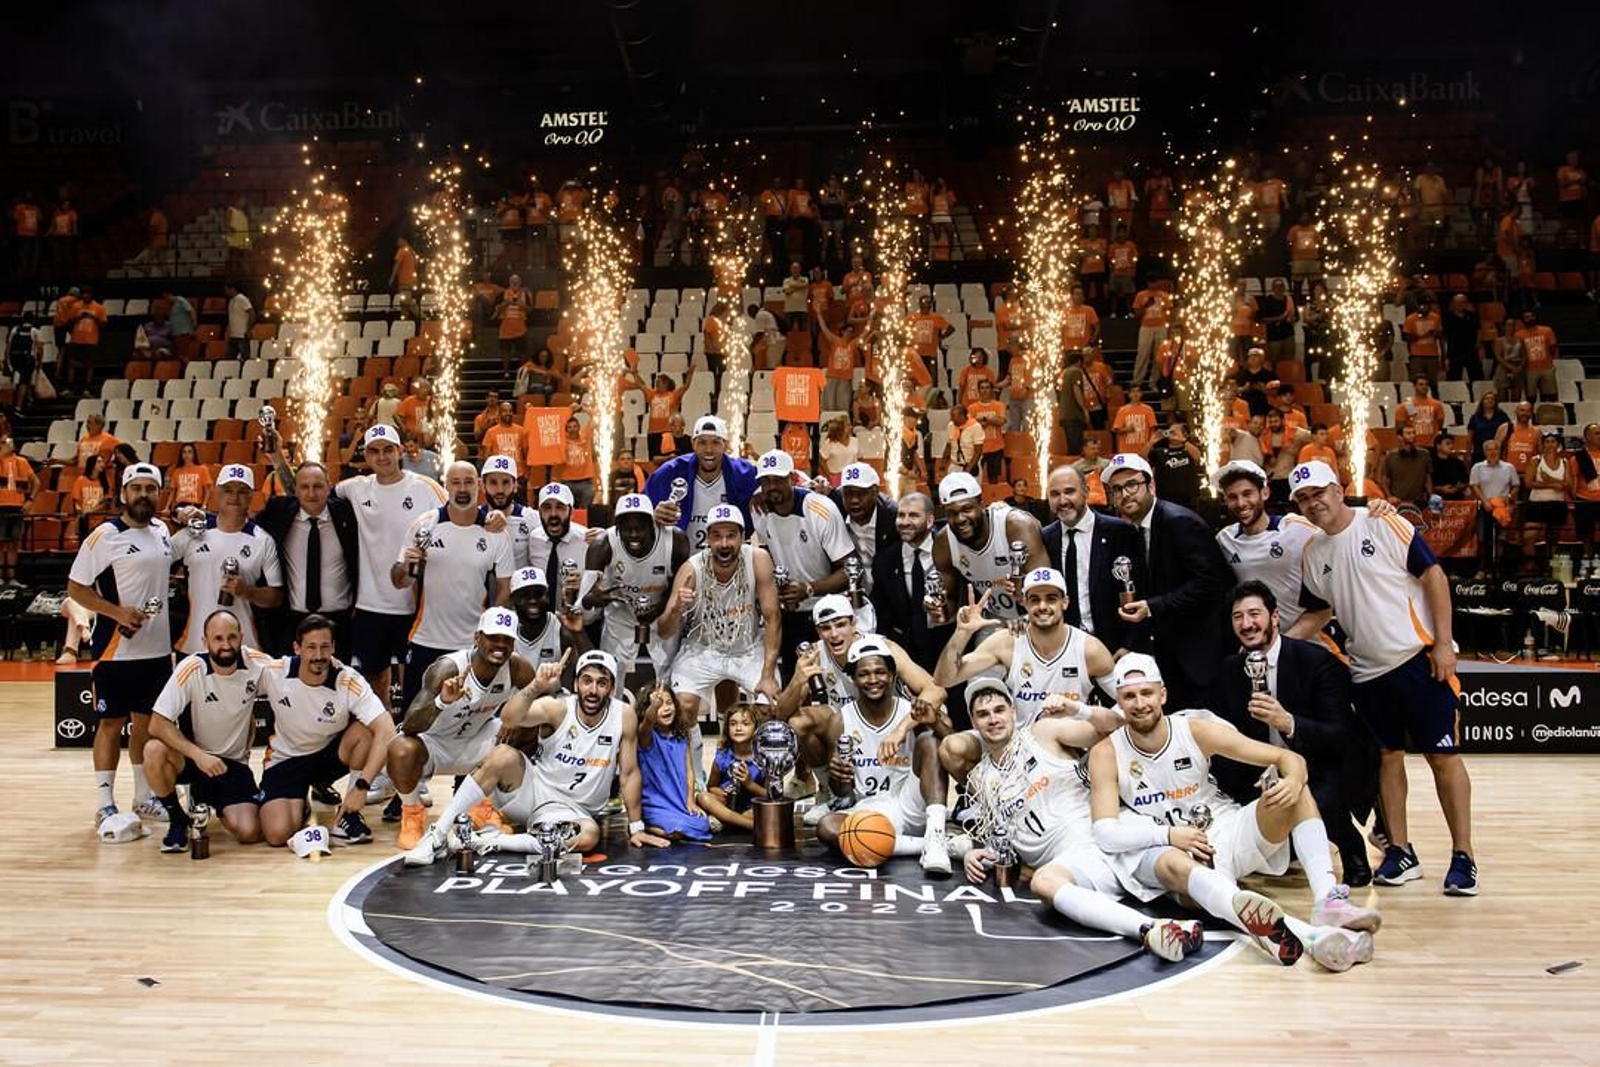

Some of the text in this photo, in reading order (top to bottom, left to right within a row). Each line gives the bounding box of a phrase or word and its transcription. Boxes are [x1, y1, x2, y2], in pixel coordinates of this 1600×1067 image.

[1073, 118, 1103, 132] Oro
[544, 132, 572, 145] Oro
[371, 426, 386, 438] 38
[494, 458, 509, 469] 38
[763, 456, 777, 468] 38
[229, 467, 245, 478] 38
[845, 468, 860, 480] 38
[1293, 466, 1310, 483] 38
[546, 484, 560, 494] 38
[625, 497, 641, 508] 38
[716, 507, 731, 518] 38
[521, 569, 537, 580] 38
[1033, 569, 1051, 582] 38
[496, 613, 512, 627] 38
[1016, 691, 1080, 702] AUTORO
[1458, 687, 1528, 707] ndesa
[1465, 726, 1514, 741] IONOS
[569, 773, 587, 790] 7
[865, 776, 890, 796] 24
[1134, 782, 1199, 806] AUTOHERO
[1024, 810, 1046, 838] 11
[304, 830, 322, 843] 38
[598, 862, 878, 879] endesa
[433, 877, 1042, 904] PLAYOFF FINAL
[769, 901, 943, 915] 2025
